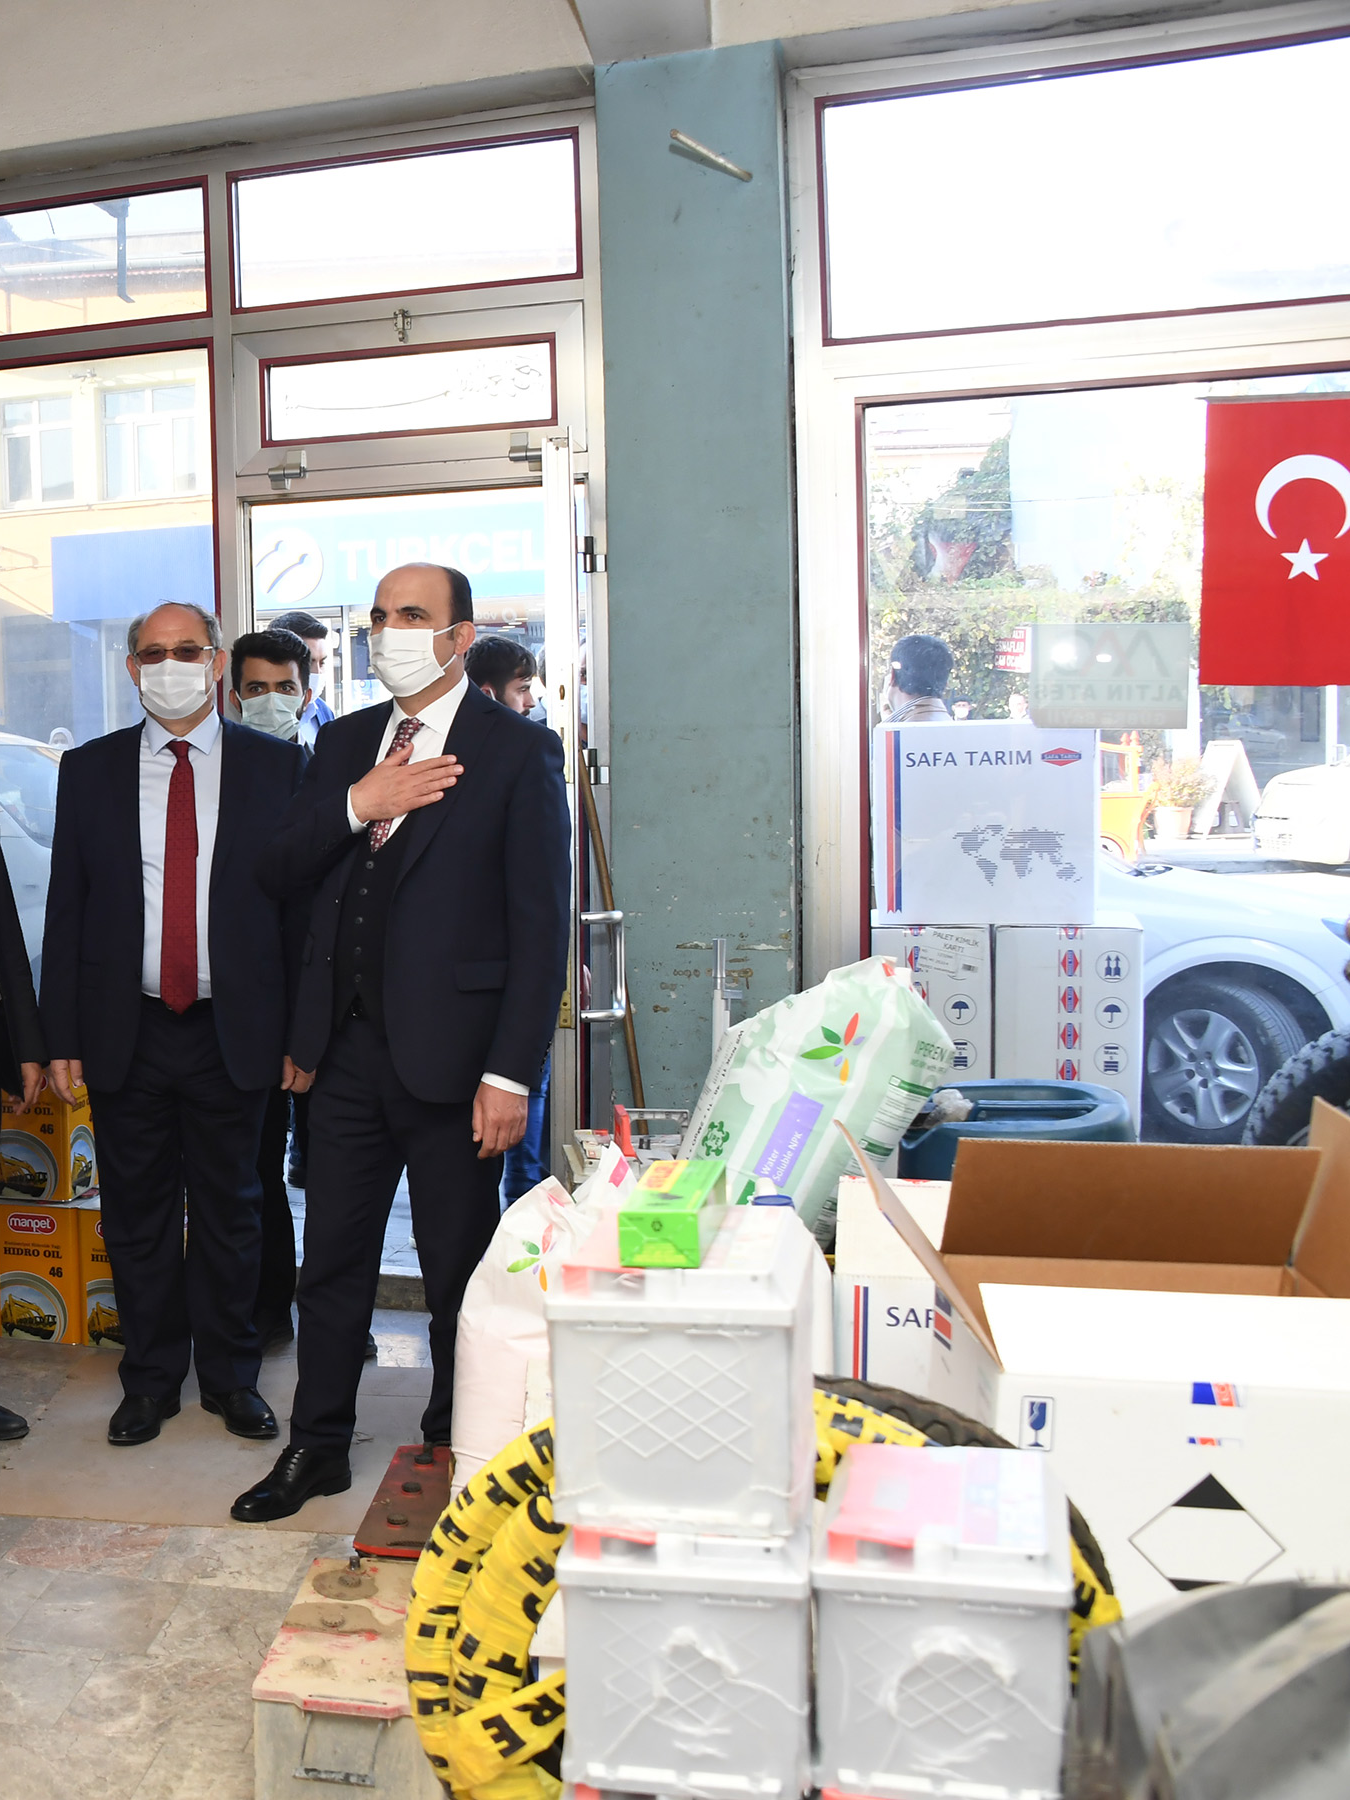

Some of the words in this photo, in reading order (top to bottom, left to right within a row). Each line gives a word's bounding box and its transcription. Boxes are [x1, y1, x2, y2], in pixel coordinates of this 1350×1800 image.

[905, 751, 958, 768] SAFA
[964, 749, 1033, 767] TARIM
[34, 1106, 54, 1116] OIL
[39, 1123, 55, 1135] 46
[760, 1148, 780, 1176] Water
[772, 1145, 794, 1182] Soluble
[788, 1130, 804, 1155] NPK
[8, 1214, 52, 1233] manpet
[3, 1246, 40, 1259] HIDRO
[43, 1248, 63, 1260] OIL
[48, 1266, 64, 1278] 46
